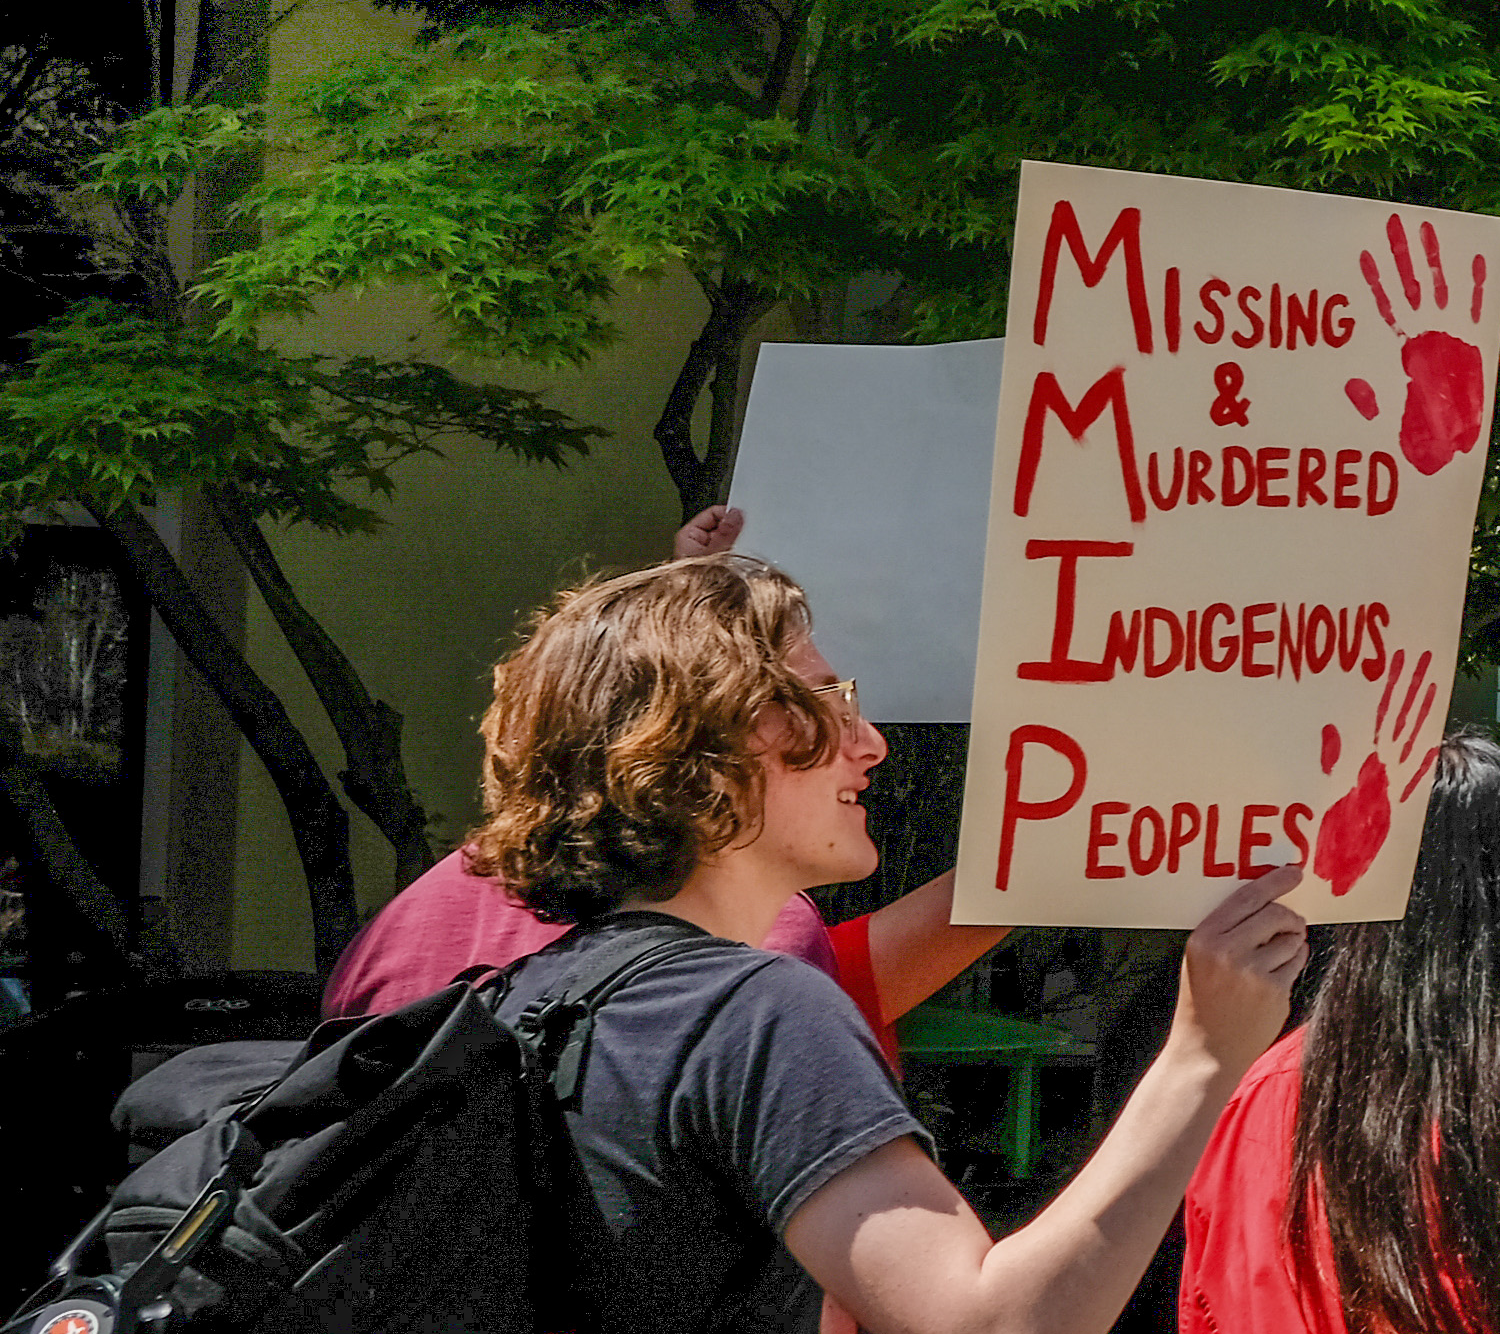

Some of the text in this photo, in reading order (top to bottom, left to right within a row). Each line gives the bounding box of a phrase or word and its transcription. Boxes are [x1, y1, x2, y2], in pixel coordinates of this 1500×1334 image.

[1033, 199, 1356, 355] MISSING
[1013, 365, 1399, 523] MURDERED
[1210, 361, 1250, 427] &
[1016, 539, 1390, 684] INDIGENOUS
[995, 724, 1313, 892] PEOPLES
